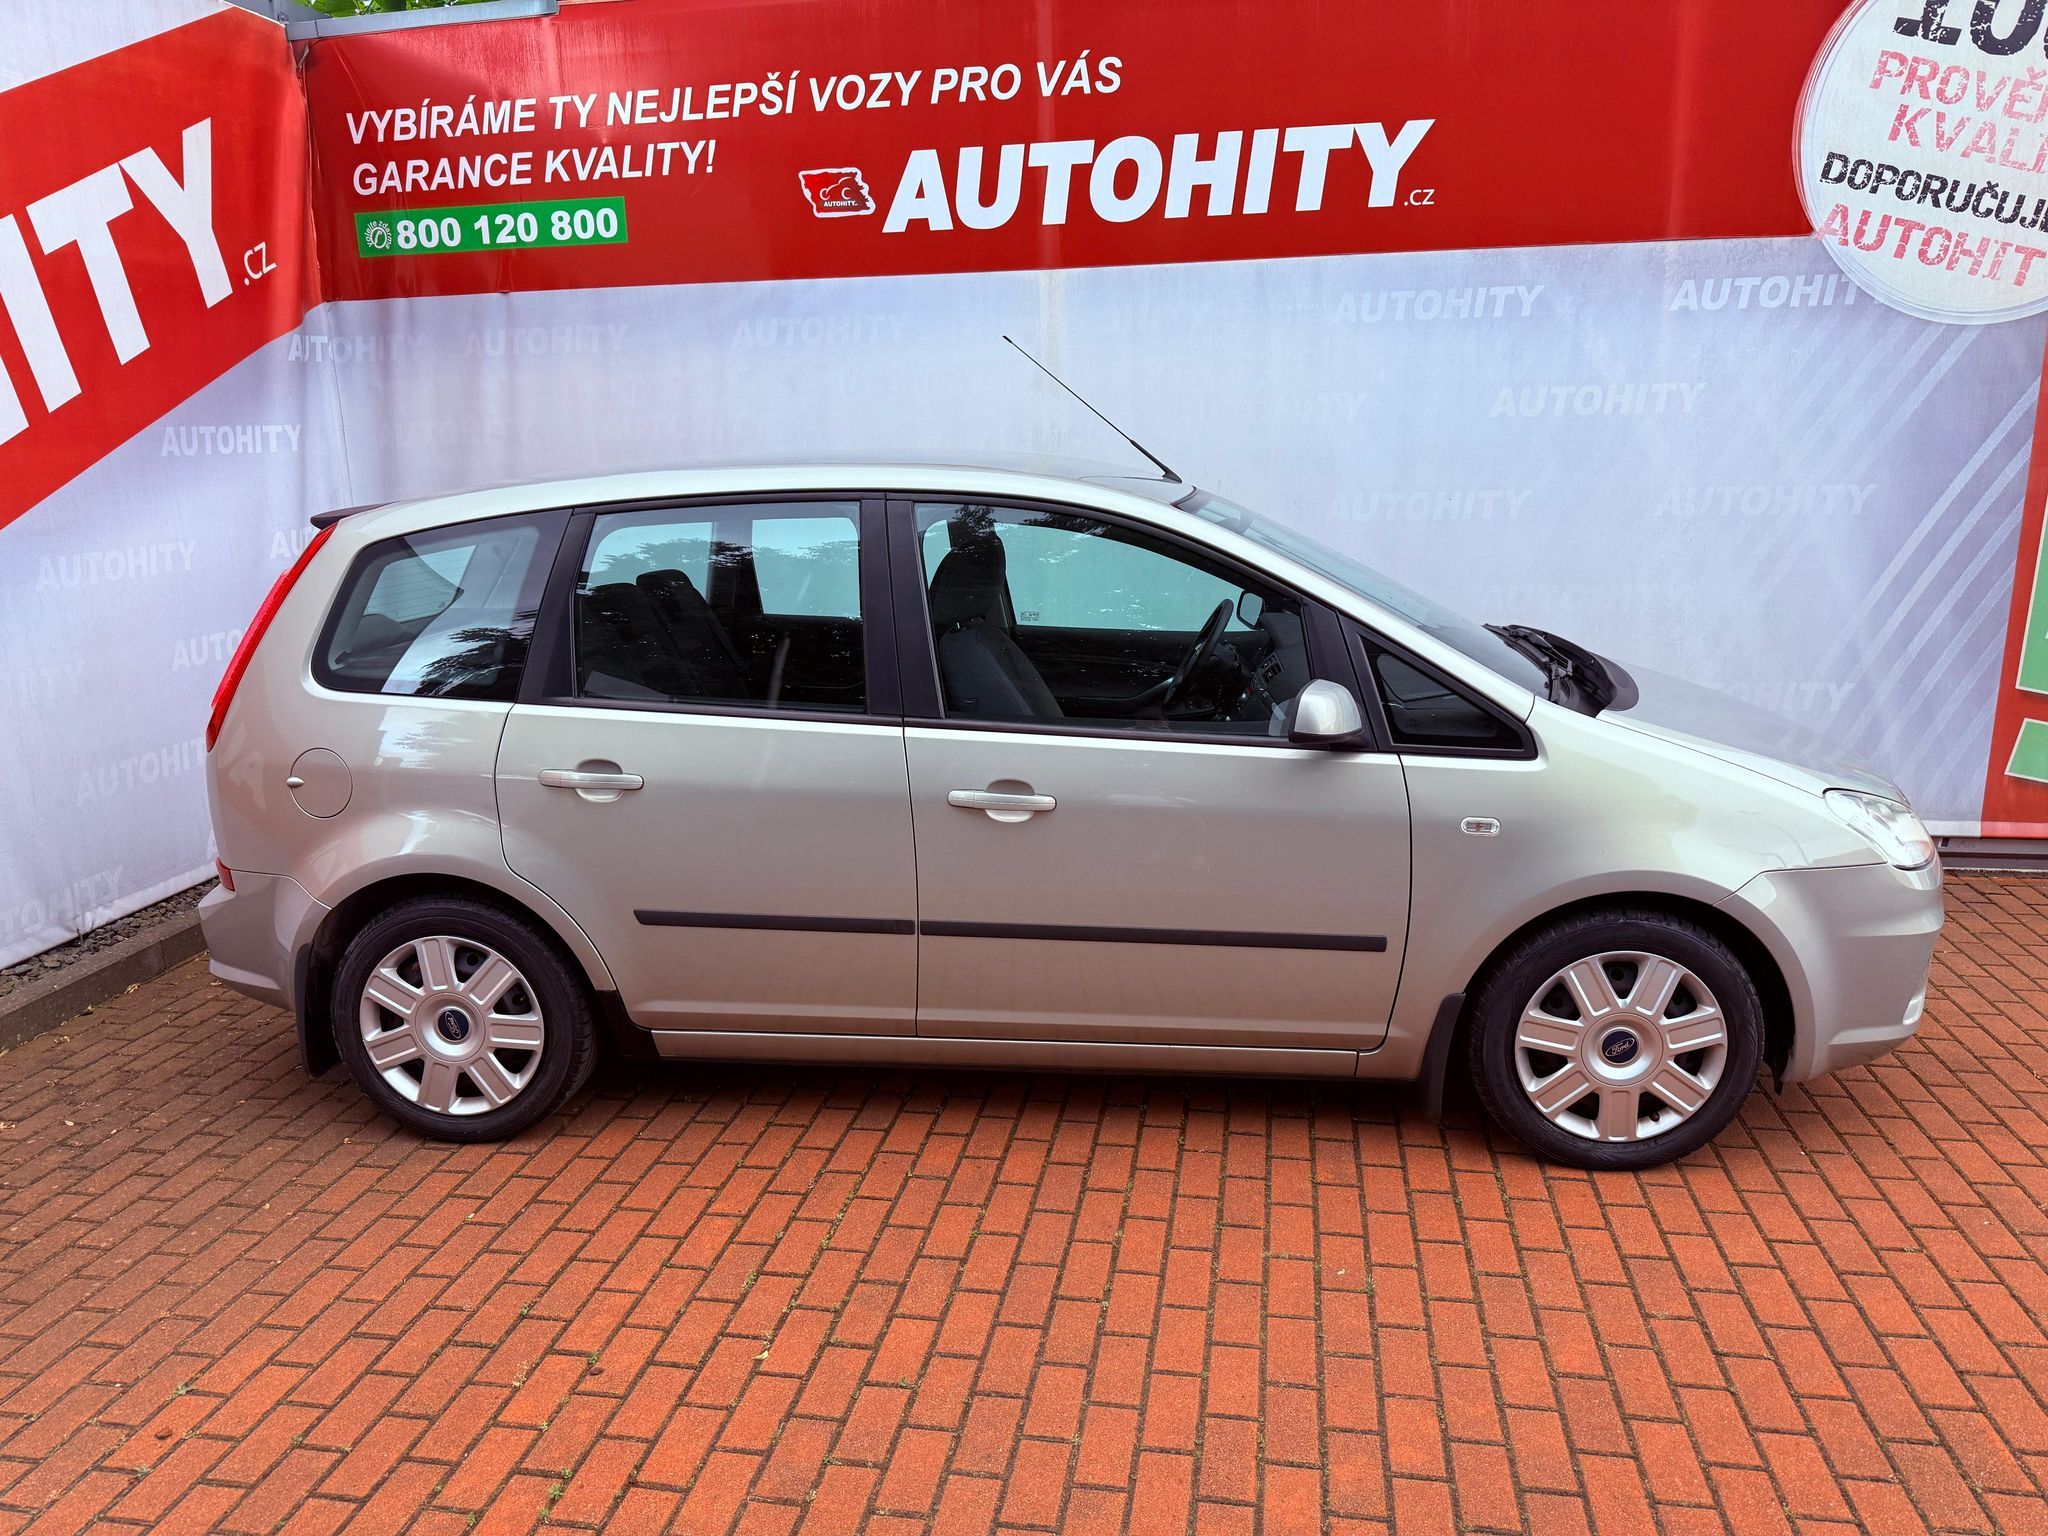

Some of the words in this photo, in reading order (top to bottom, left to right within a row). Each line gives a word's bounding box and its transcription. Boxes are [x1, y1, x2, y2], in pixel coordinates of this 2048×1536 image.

[347, 94, 537, 145] VYBÍRÁME
[548, 92, 599, 130] TY
[606, 69, 800, 127] NEJLEPŠÍ
[808, 70, 924, 112] VOZY
[930, 64, 1022, 105] PRO
[1036, 49, 1123, 97] VÁS
[1869, 50, 2048, 124] PROVĚ
[353, 152, 533, 196] GARANCE
[545, 139, 716, 184] KVALITY!
[882, 119, 1435, 234] AUTOHITY
[823, 200, 856, 208] AUTOHITY
[397, 218, 462, 250] 800
[473, 212, 540, 245] 120
[550, 207, 619, 241] 800
[1331, 285, 1546, 324] AUTOHITY
[1668, 274, 1880, 312] AUTOHIT
[463, 323, 629, 359] AUTOHITY
[731, 313, 912, 348] AUTOHITY
[1488, 382, 1708, 417] AUTOHITY
[161, 423, 302, 457] AUTOHITY
[1327, 488, 1534, 522] AUTOHITY
[1653, 483, 1878, 518] AUTOHITY
[36, 540, 199, 592] AUTOHITY
[172, 627, 249, 671] AUTO
